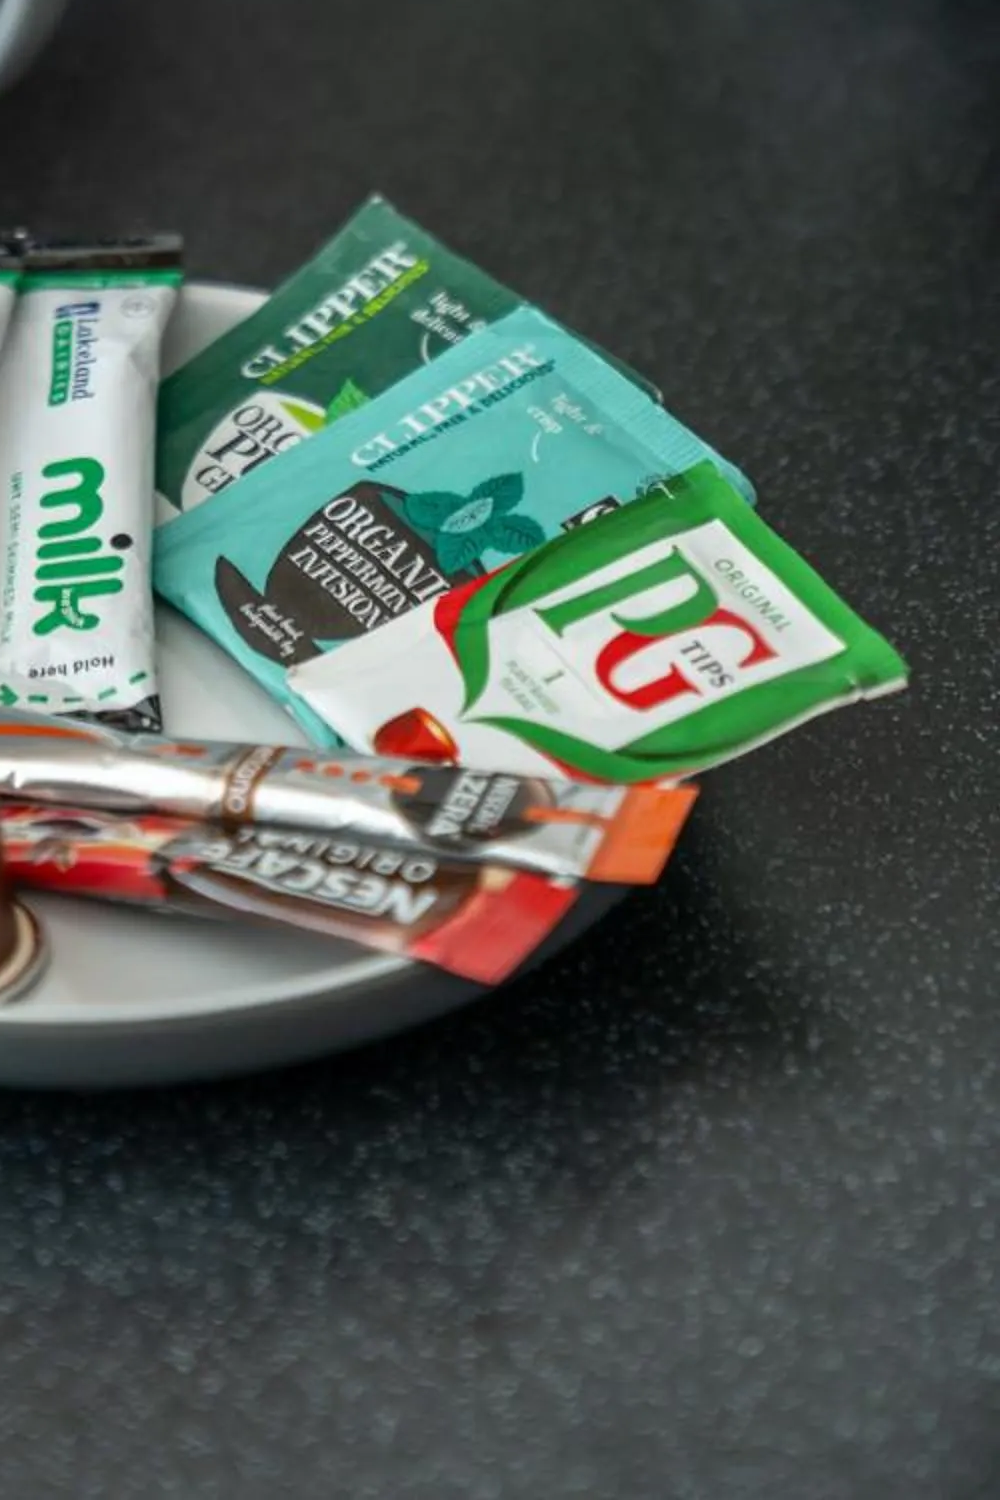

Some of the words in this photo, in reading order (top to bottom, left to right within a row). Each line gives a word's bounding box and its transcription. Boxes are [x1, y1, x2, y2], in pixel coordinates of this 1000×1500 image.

[241, 249, 418, 379] CLIPPER
[49, 321, 72, 405] DAIRIES
[71, 318, 99, 401] Lakeland
[351, 349, 541, 466] CLIPPER
[32, 457, 134, 636] milk
[304, 522, 411, 613] PEPPERMIN
[323, 496, 451, 601] ORGANI
[532, 544, 780, 713] PG
[714, 558, 793, 633] ORIGINAL
[28, 662, 67, 679] here
[73, 655, 115, 675] Hold
[680, 640, 735, 689] TIPS
